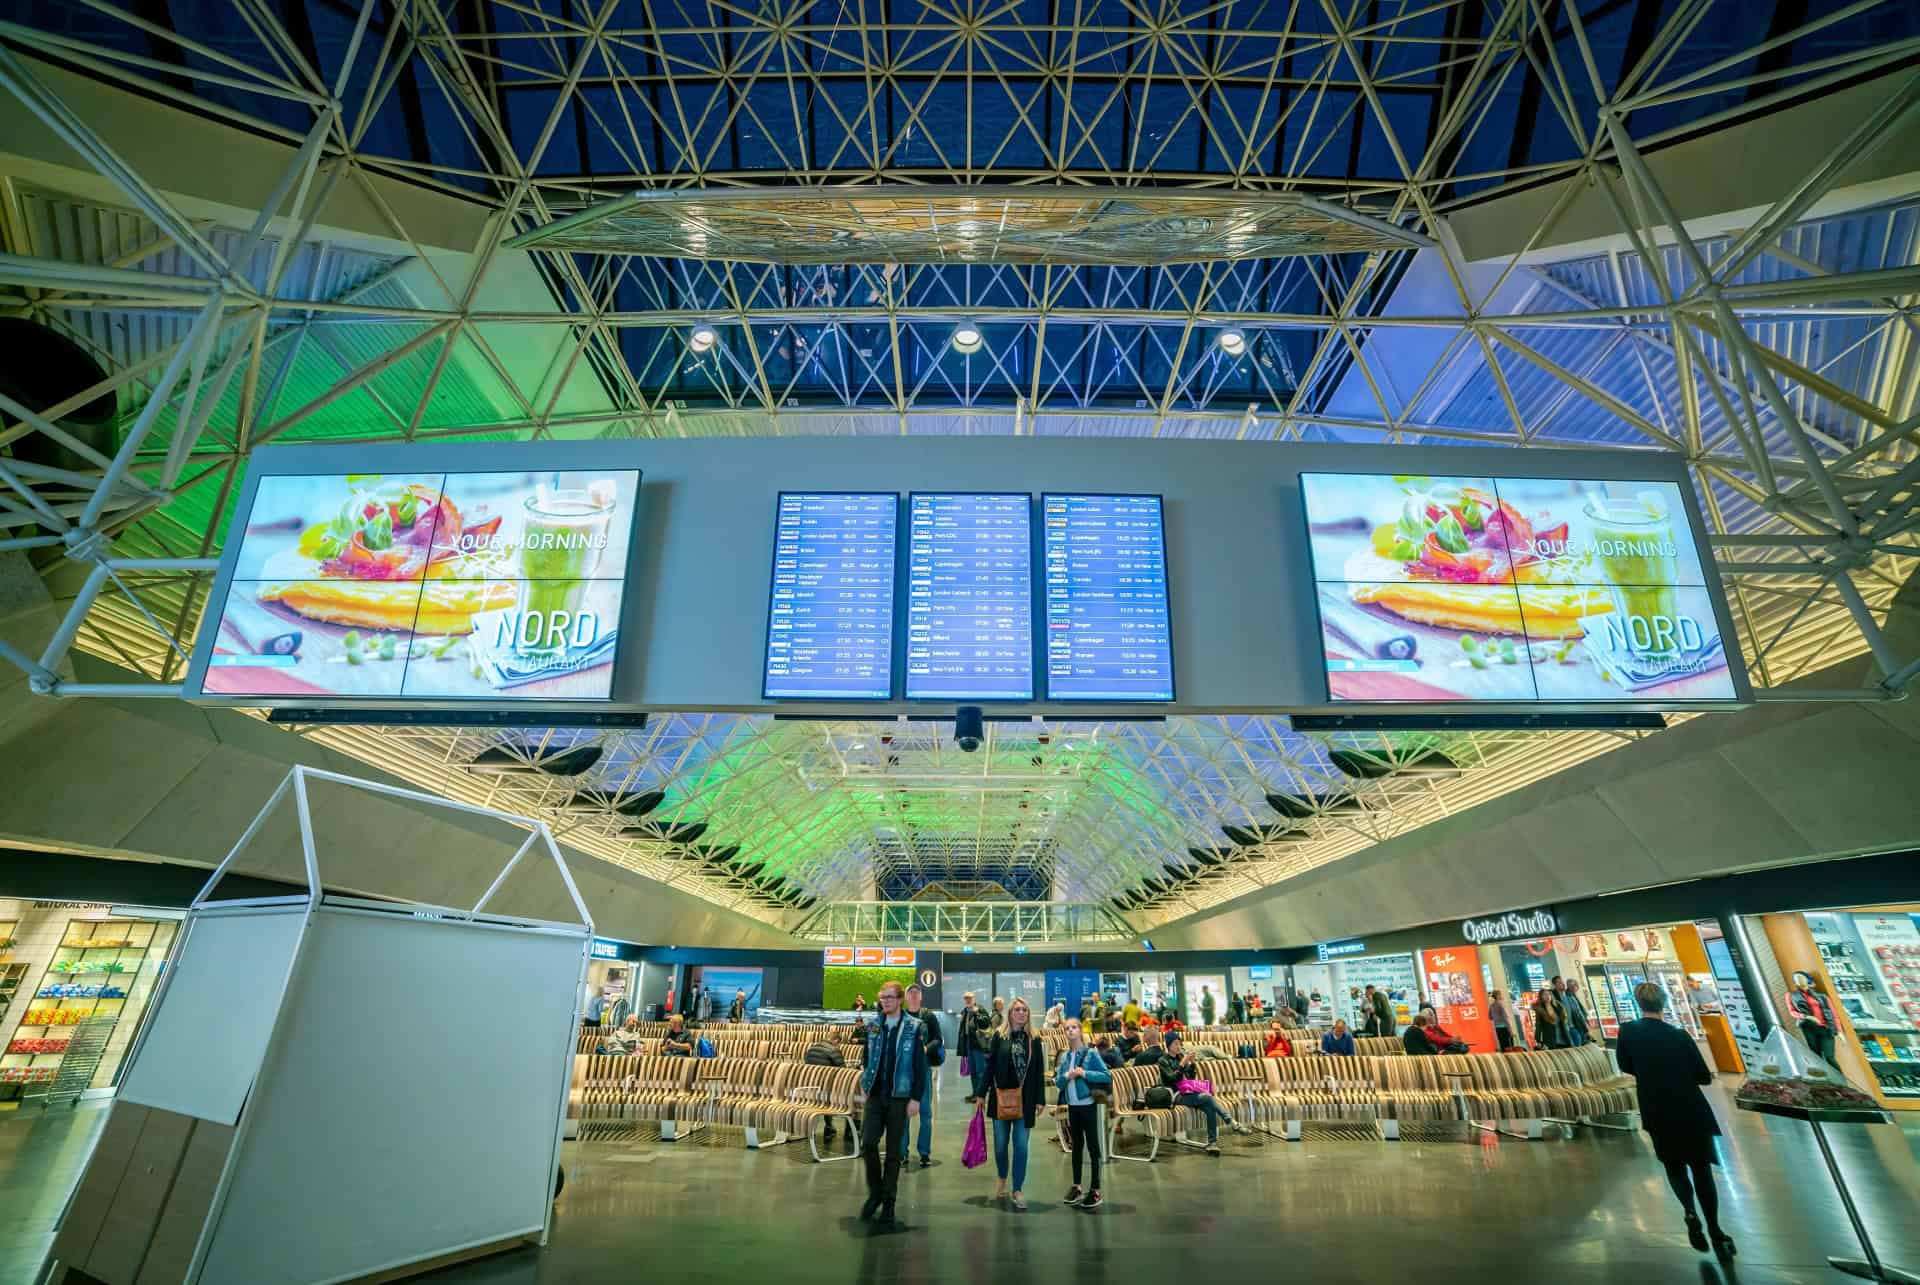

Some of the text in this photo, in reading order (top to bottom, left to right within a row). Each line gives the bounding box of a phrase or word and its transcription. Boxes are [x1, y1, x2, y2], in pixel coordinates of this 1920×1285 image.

[508, 533, 609, 551] MORNING
[1583, 539, 1678, 558] MORNING
[496, 609, 598, 649] NORD
[1603, 615, 1704, 652] NORD
[1463, 911, 1556, 945] Optical Studio
